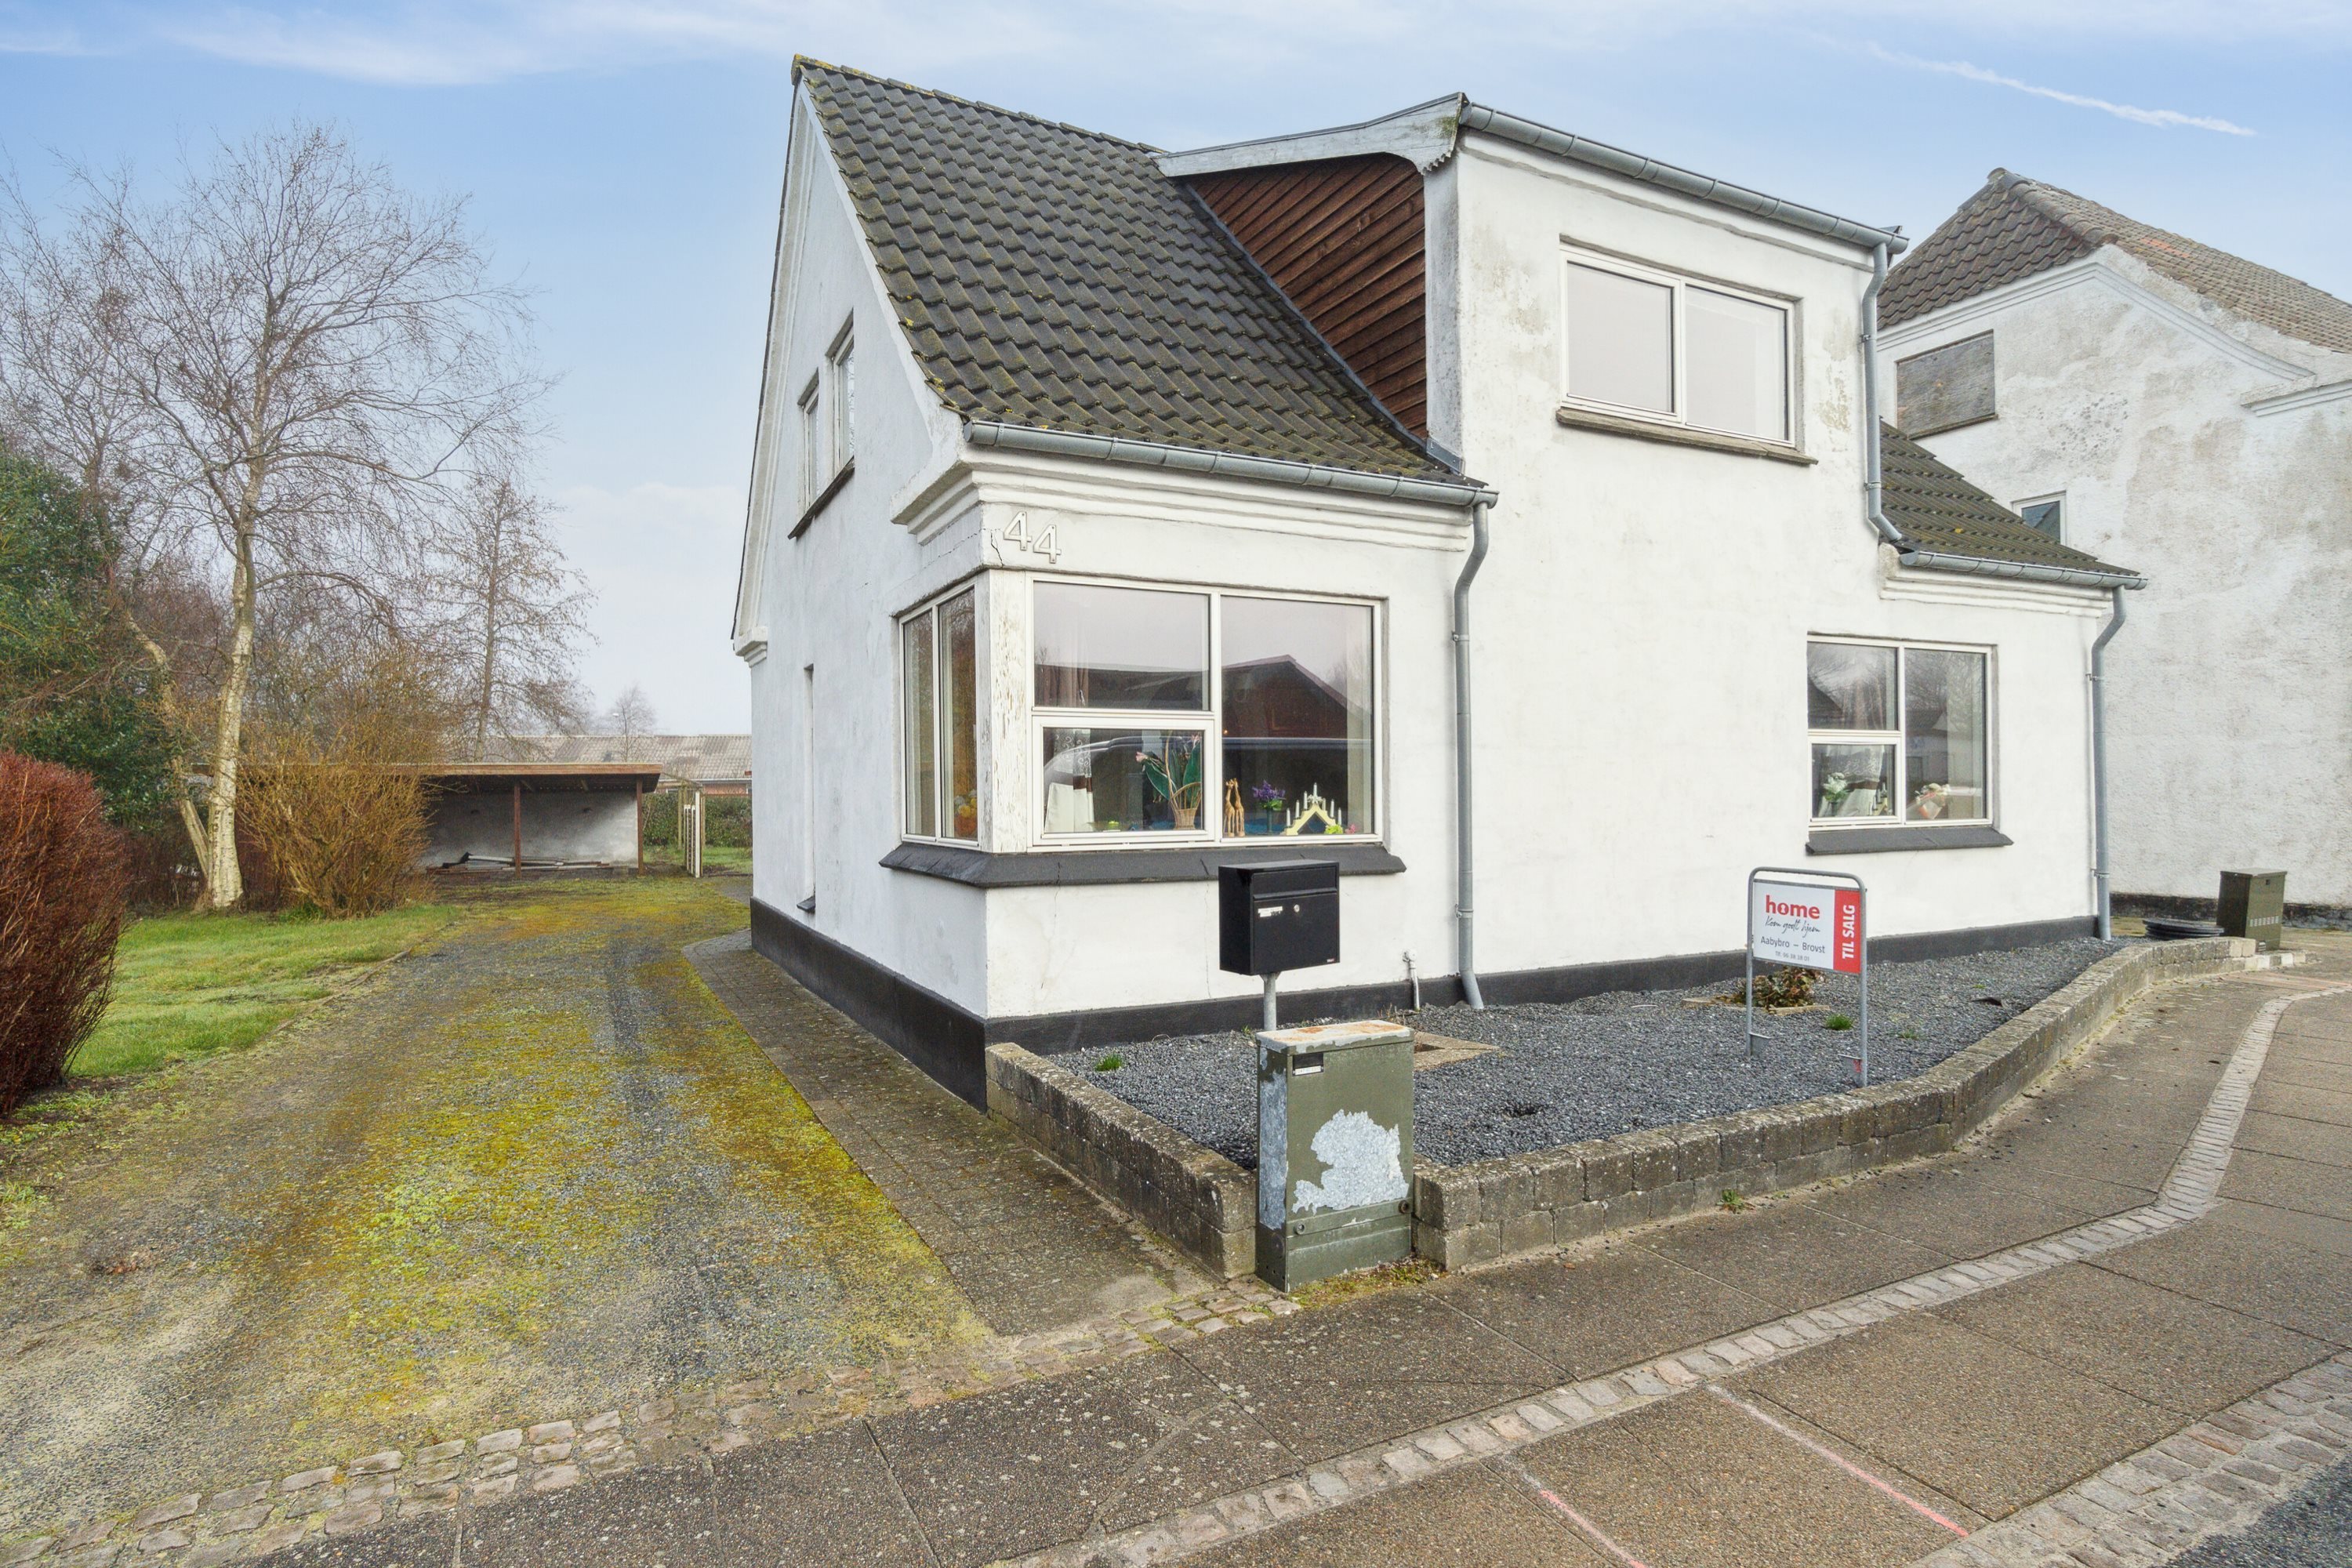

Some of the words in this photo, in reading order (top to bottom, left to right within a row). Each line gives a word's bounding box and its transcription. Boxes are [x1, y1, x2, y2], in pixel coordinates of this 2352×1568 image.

[1003, 511, 1062, 564] 44
[1766, 895, 1820, 920] home
[1765, 915, 1781, 927] Kom
[1781, 919, 1801, 935] godt
[1801, 920, 1821, 938] hjem
[1842, 905, 1856, 938] SALG
[1760, 936, 1790, 948] Aabybro
[1802, 942, 1826, 954] Brovst
[1842, 942, 1854, 960] TIL
